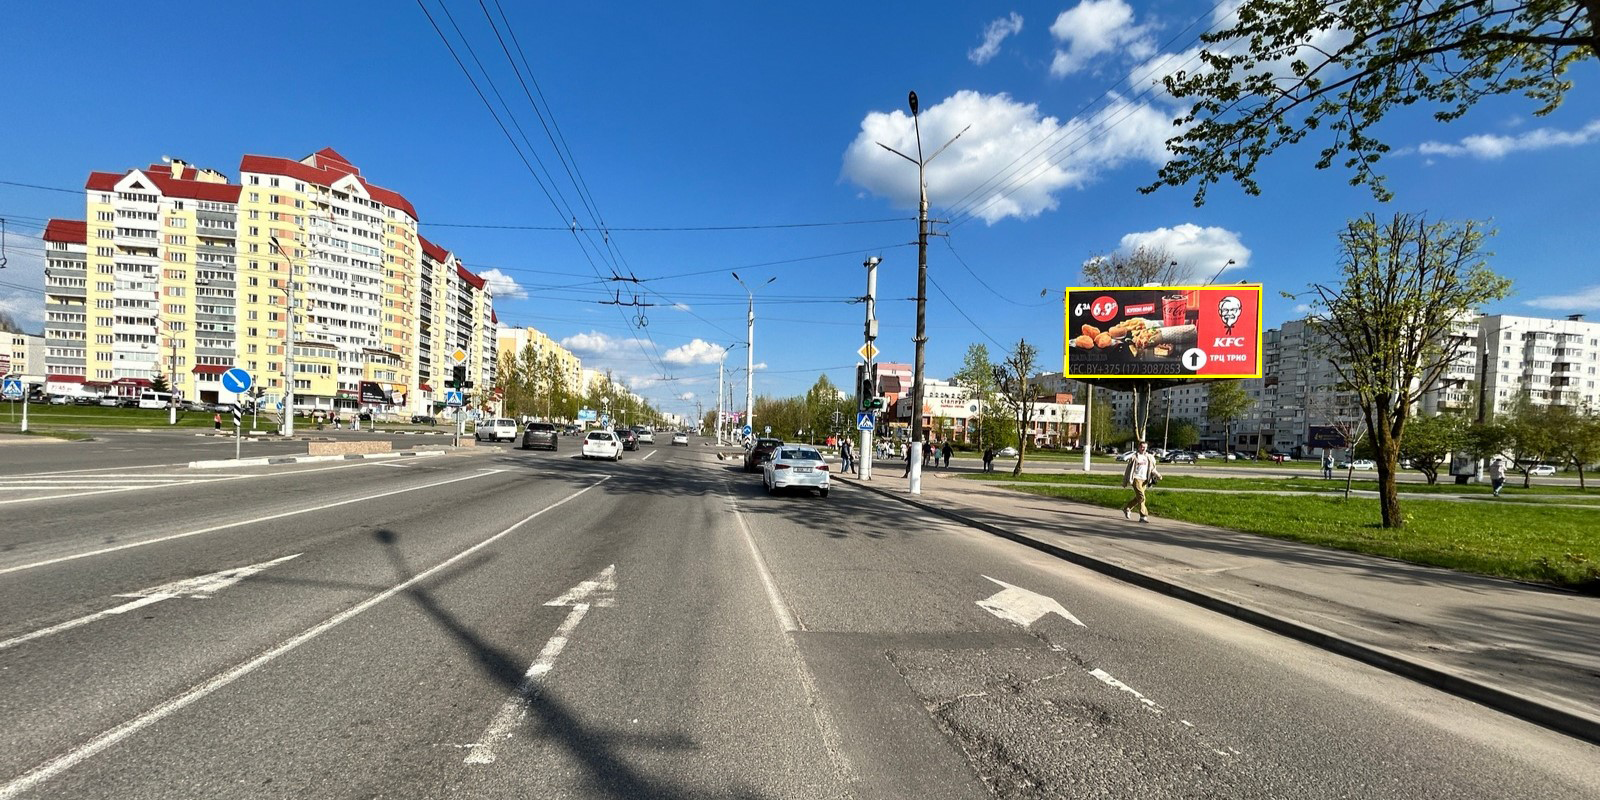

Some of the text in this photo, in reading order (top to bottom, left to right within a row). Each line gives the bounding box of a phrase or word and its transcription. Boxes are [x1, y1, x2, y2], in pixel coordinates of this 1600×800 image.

[1213, 337, 1245, 348] KFC
[1210, 354, 1247, 363] ТРЦ ТРИО
[1122, 363, 1140, 375] (17)
[1142, 363, 1181, 374] 3087853
